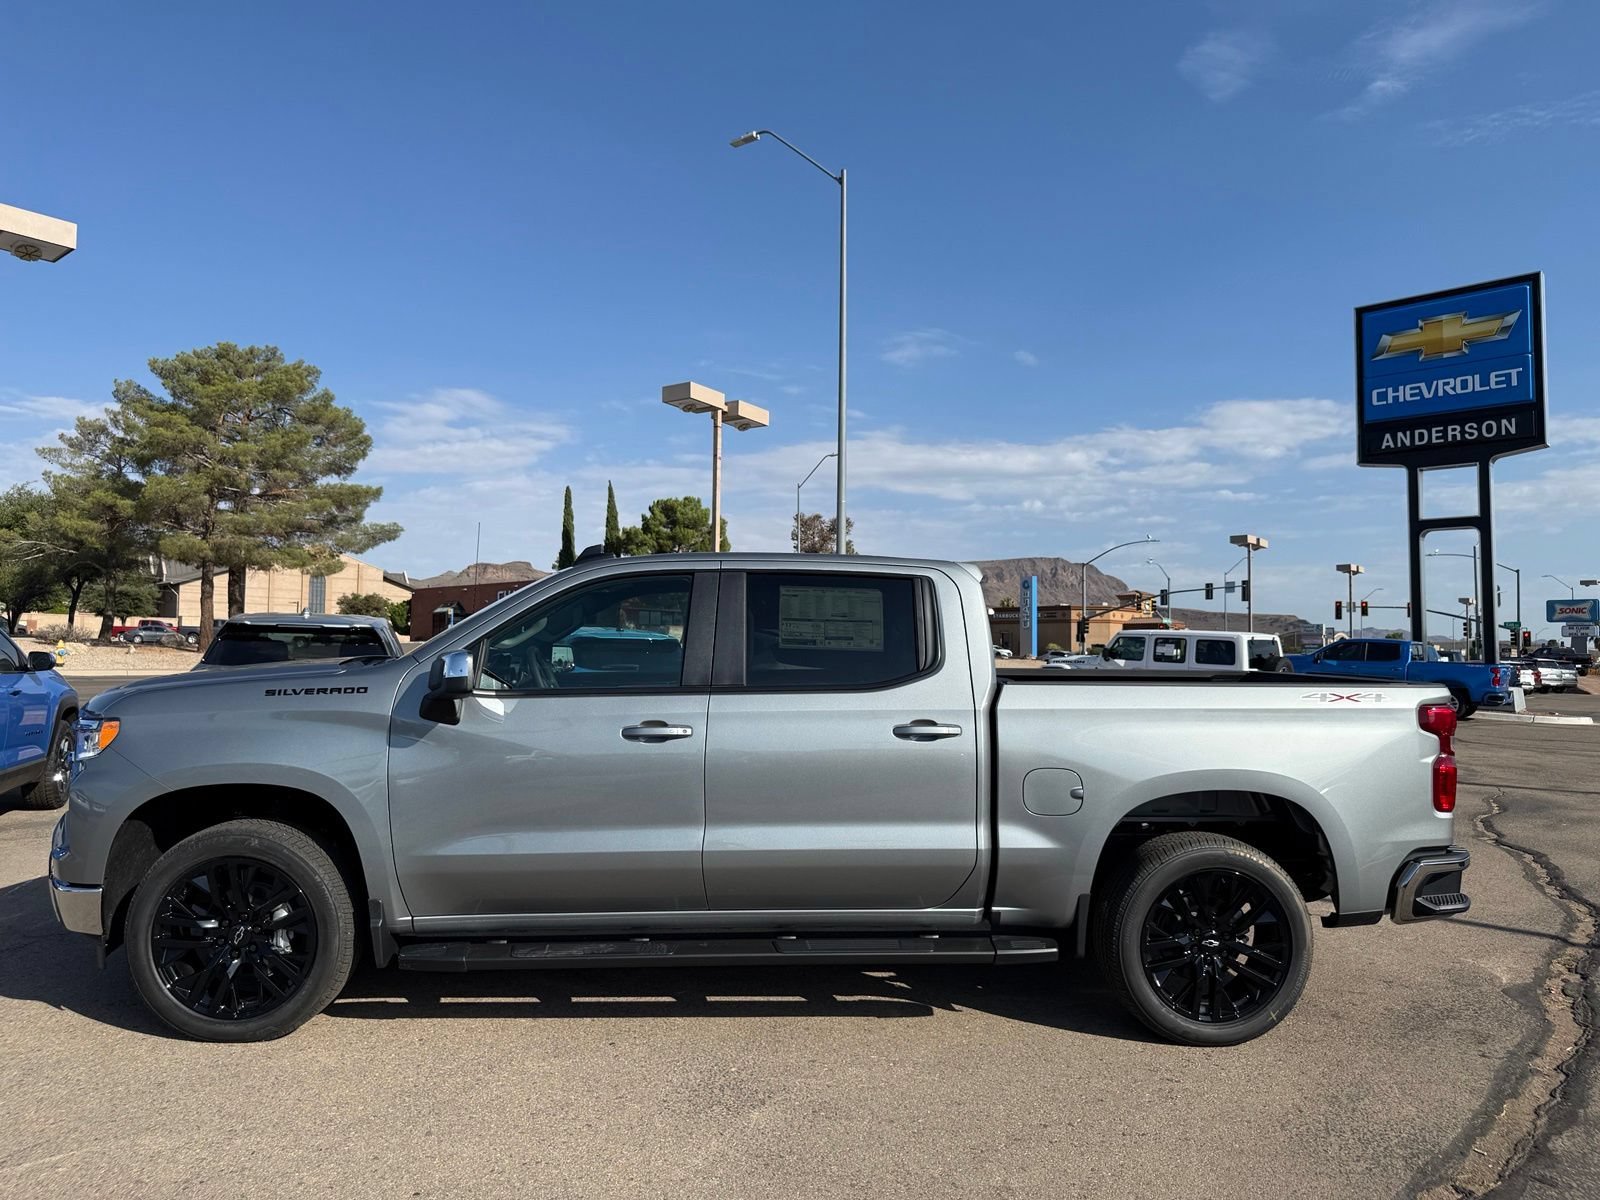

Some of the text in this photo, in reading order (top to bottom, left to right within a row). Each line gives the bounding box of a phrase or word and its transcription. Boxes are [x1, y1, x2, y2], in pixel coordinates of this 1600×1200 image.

[1371, 367, 1523, 406] CHEVROLET
[1381, 417, 1516, 450] ANDERSON
[1022, 592, 1031, 630] CHASE
[1558, 607, 1588, 615] SONIC
[264, 686, 369, 697] SILVERADO
